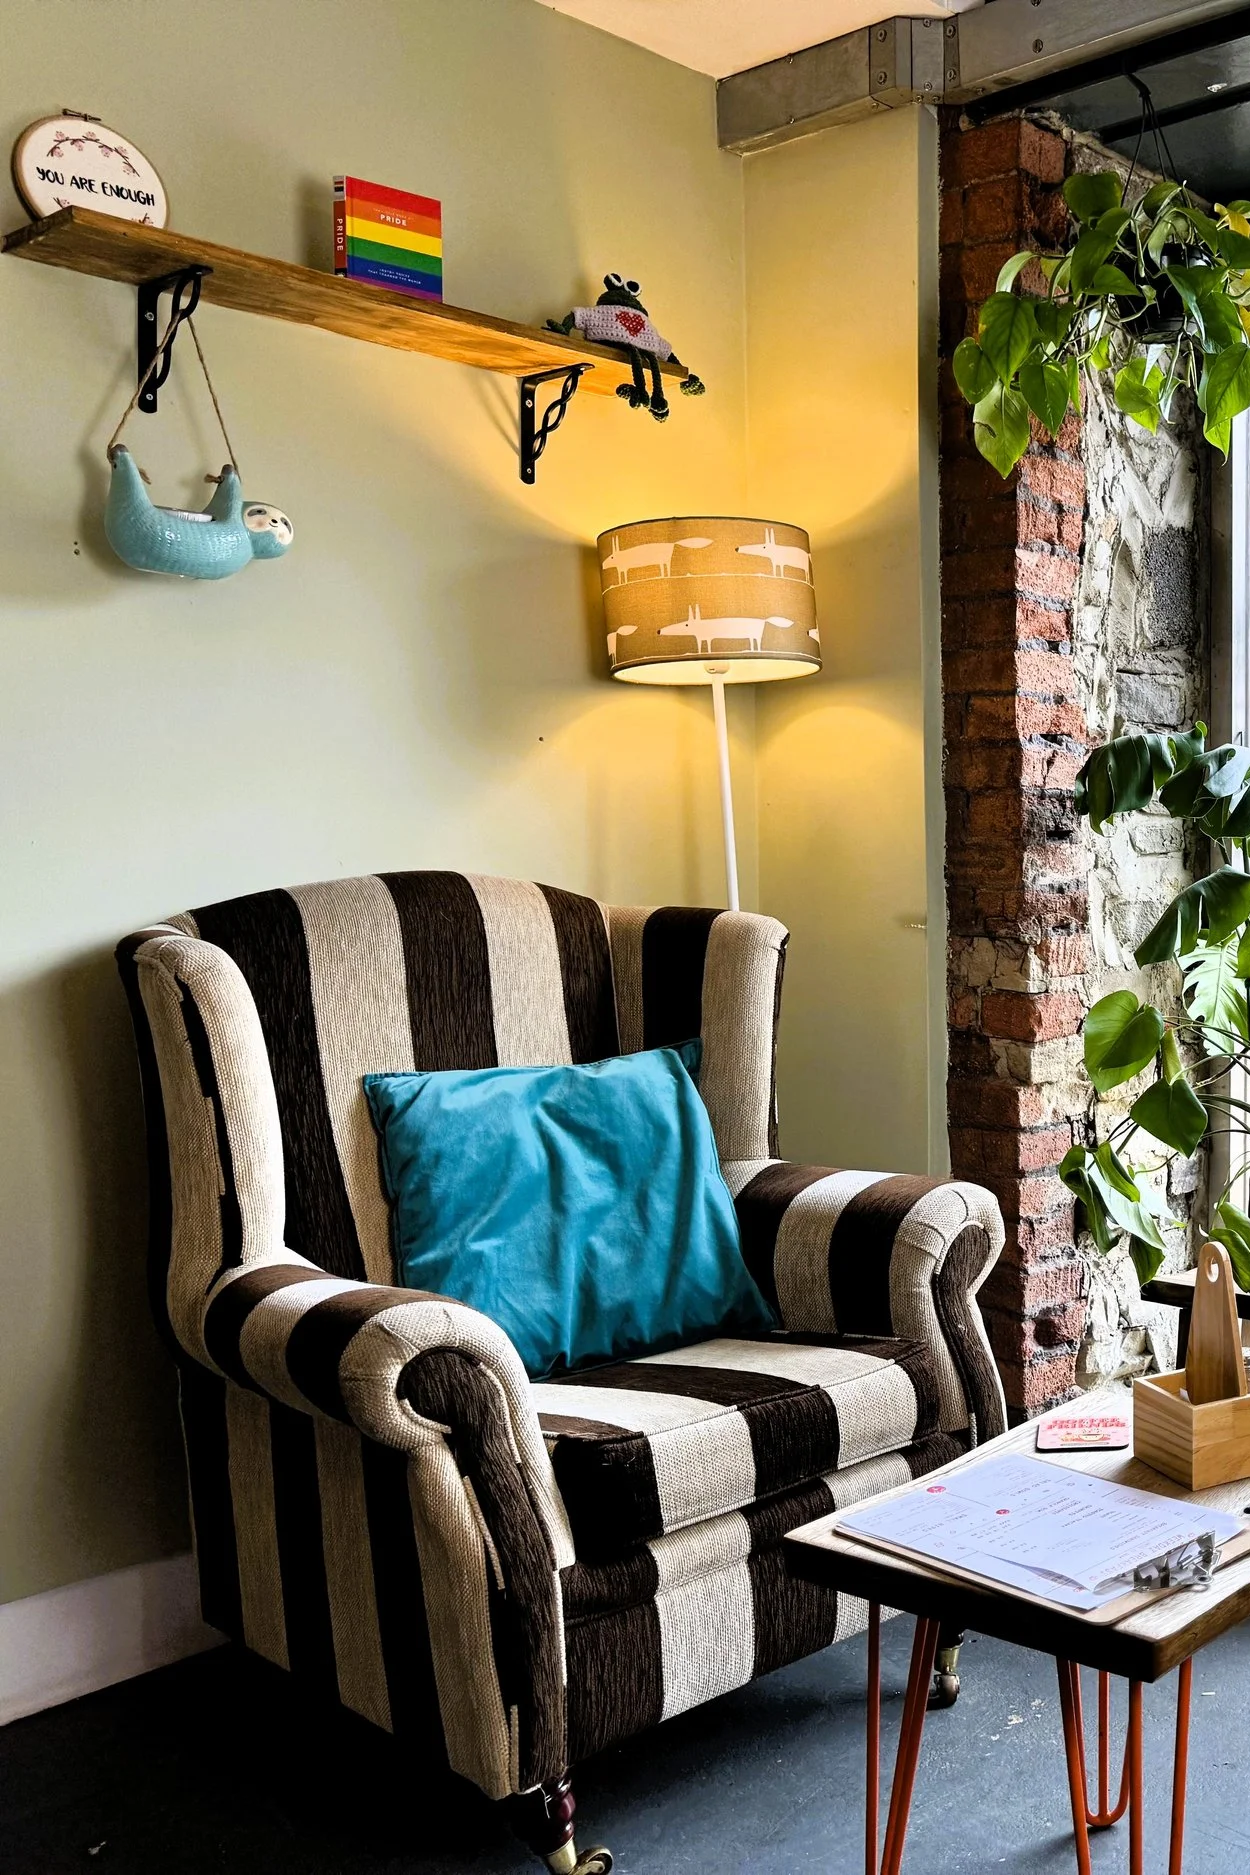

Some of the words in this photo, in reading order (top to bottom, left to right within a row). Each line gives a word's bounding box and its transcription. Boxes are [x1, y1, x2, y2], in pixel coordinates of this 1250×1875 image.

[36, 166, 65, 186] YOU
[70, 175, 98, 194] ARE
[101, 181, 155, 207] ENOUGH
[380, 213, 408, 227] PRIDE
